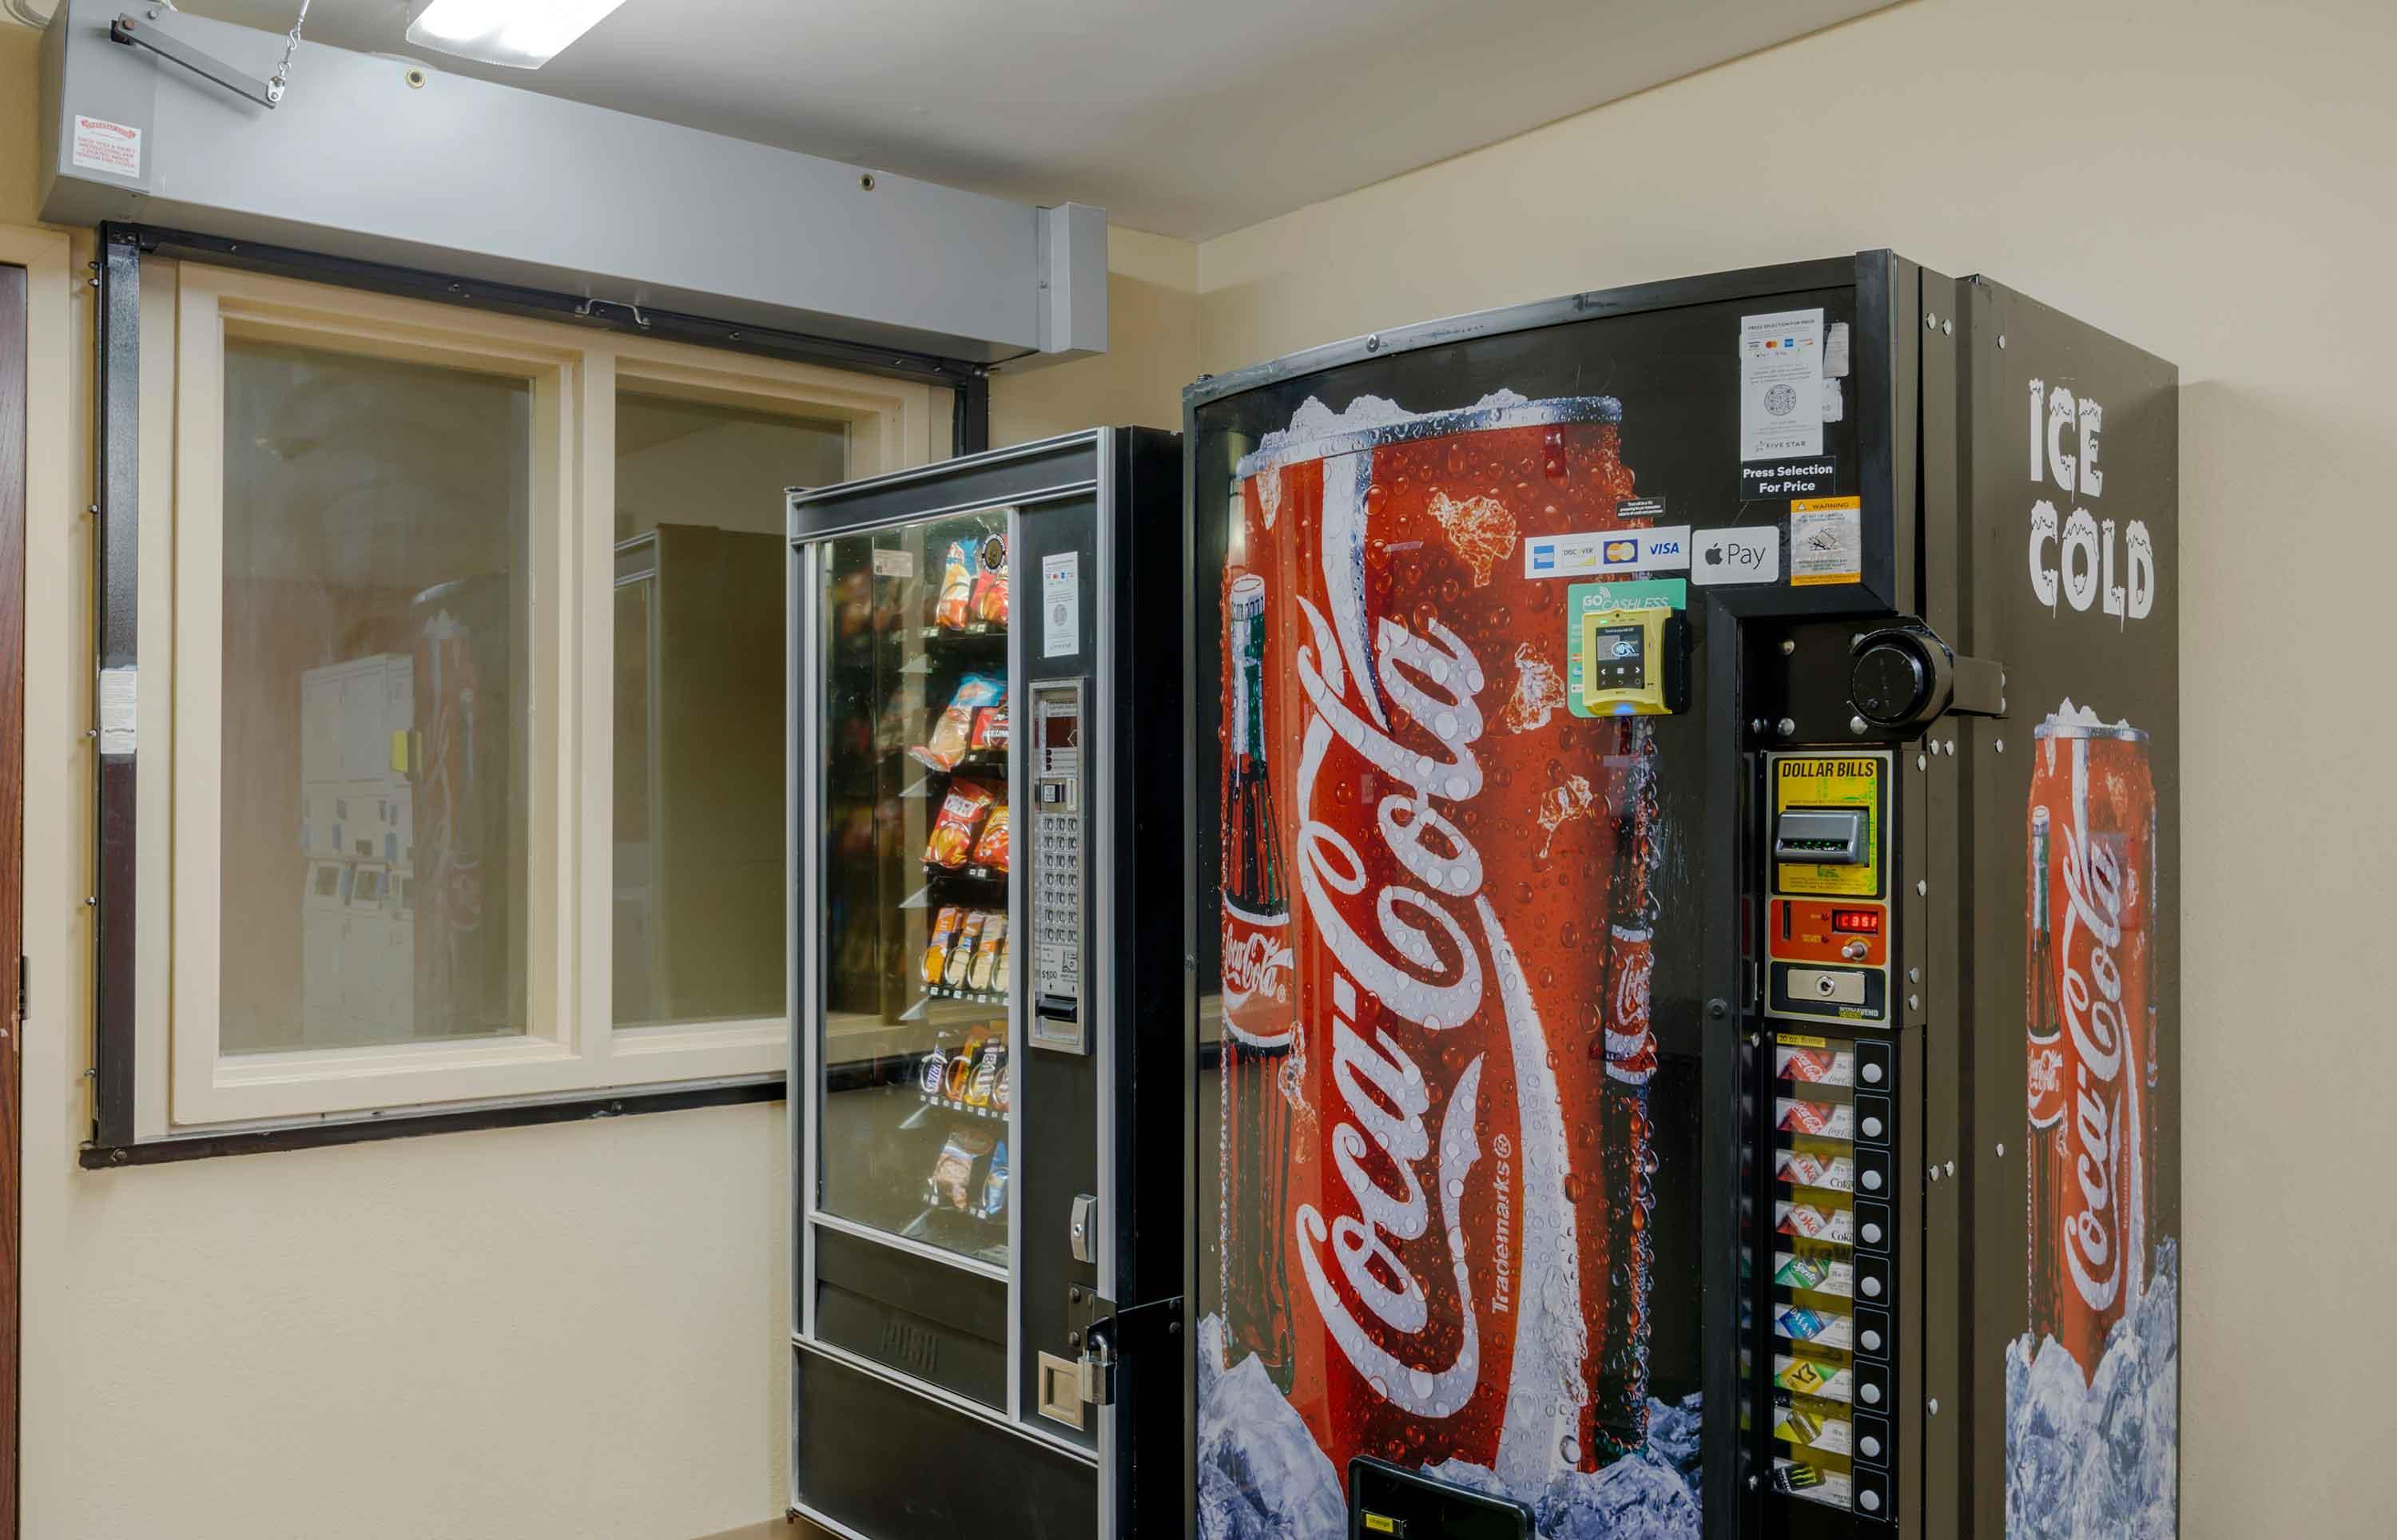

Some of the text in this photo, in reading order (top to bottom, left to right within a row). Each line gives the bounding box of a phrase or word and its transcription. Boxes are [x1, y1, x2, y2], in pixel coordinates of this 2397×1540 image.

[2029, 378, 2103, 505] ICE
[1743, 464, 1833, 478] Press Selection
[1759, 481, 1815, 493] For Price
[1649, 542, 1679, 555] VISA
[1727, 543, 1766, 569] Pay
[2029, 499, 2155, 633] COLD
[1583, 595, 1669, 609] GO CASHLESS
[1782, 762, 1874, 777] DOLLAR BILLS
[1296, 594, 1484, 1419] Coca-Cola
[2063, 823, 2121, 1311] Coca-Cola
